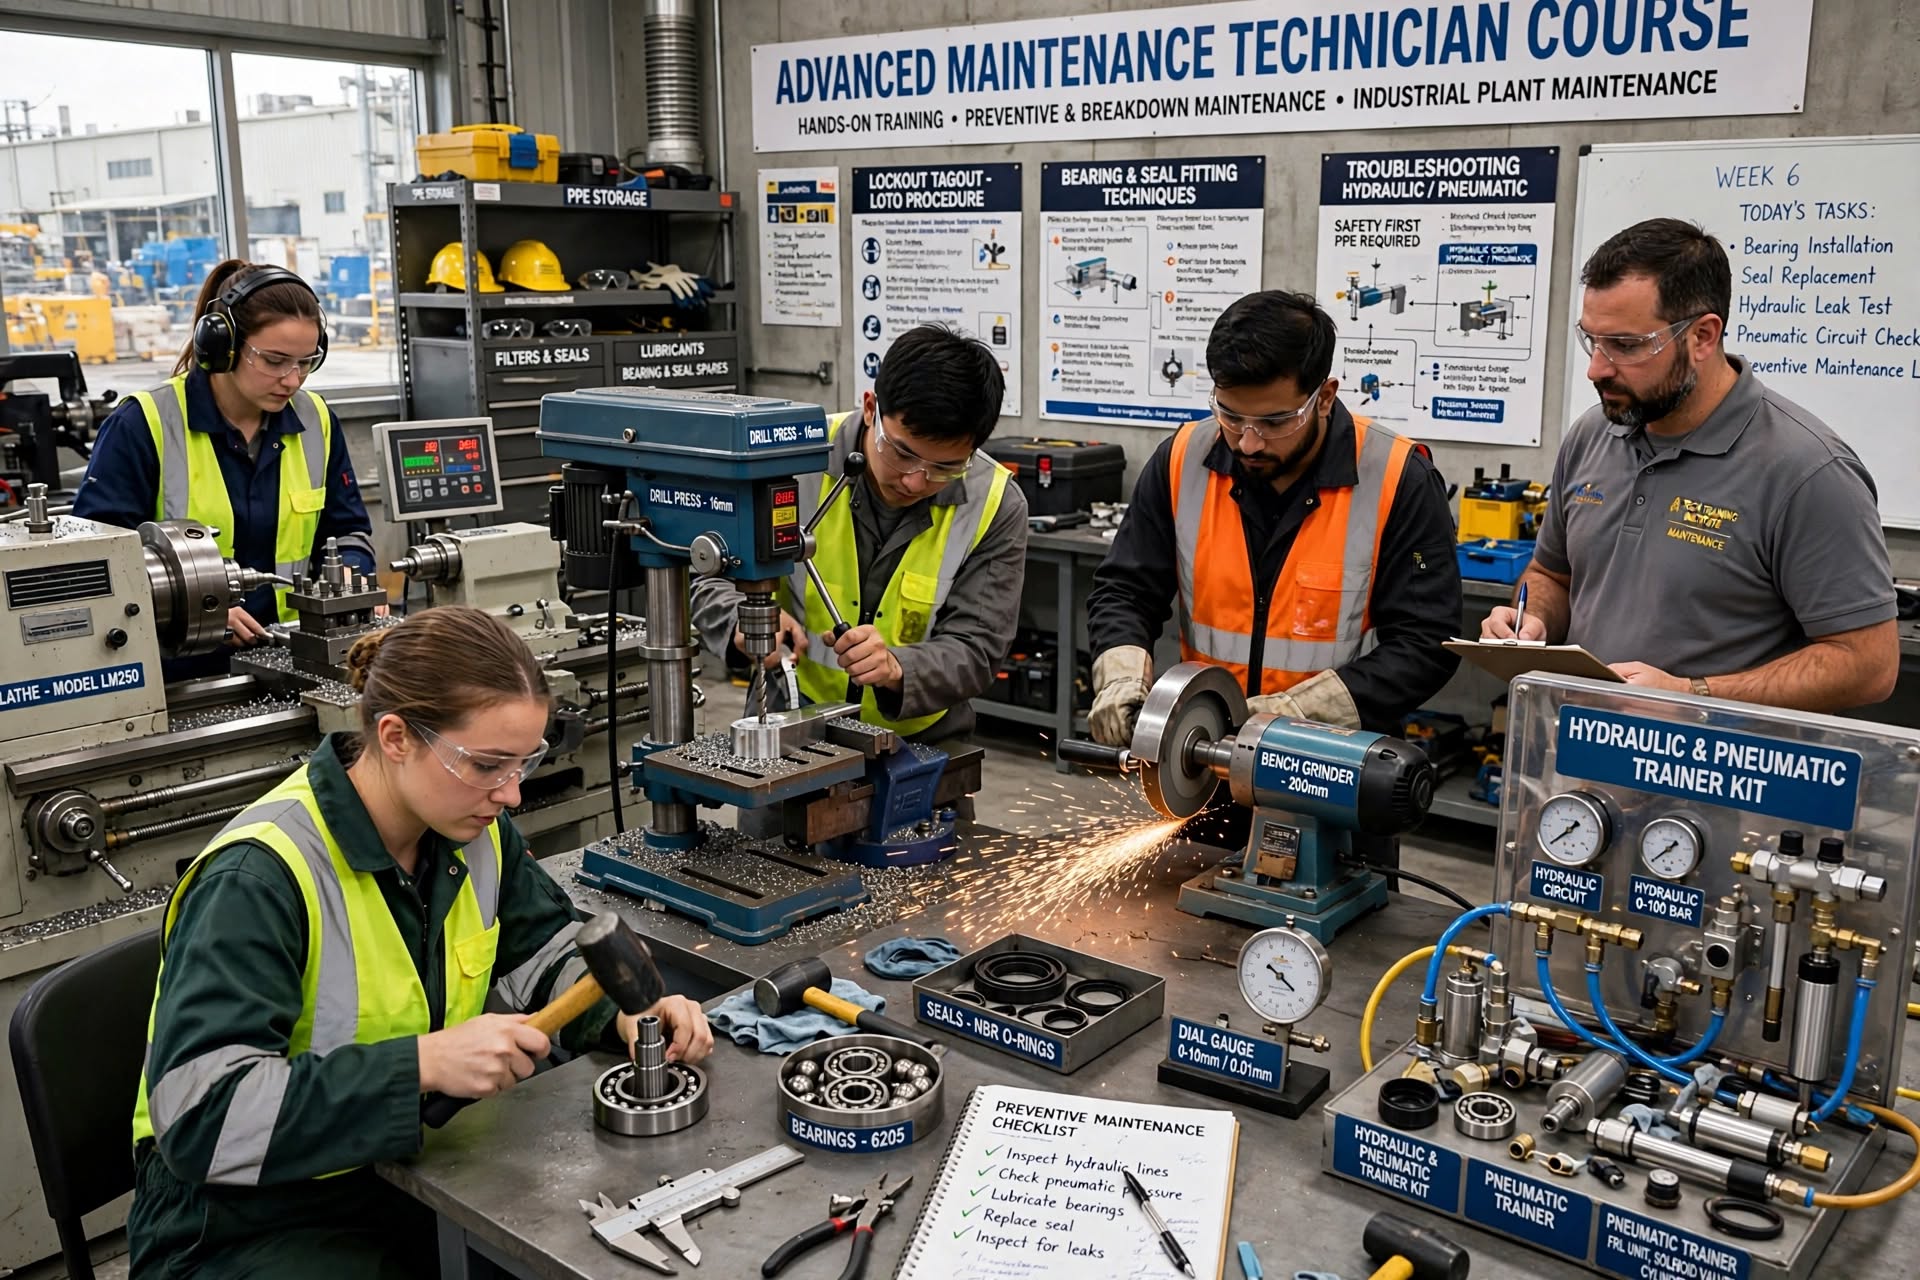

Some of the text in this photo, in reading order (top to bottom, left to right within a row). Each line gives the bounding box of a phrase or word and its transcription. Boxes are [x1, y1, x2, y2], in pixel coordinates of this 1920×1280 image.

[776, 0, 1749, 104] ADVANCED MAINTENANCE TECHNICIAN COURSE
[798, 70, 1718, 135] HANDS-ON TRAINING PREVENTIVE & BREAKDOWN MAINTENANCE INDUSTRIAL PLANT MAINTENANCE
[869, 172, 928, 190] LOCKOUT
[930, 170, 984, 188] TAGOUT
[1061, 163, 1238, 185] BEARING & SEAL FITTING
[1347, 156, 1520, 179] TROUBLESHOOTING
[1715, 163, 1800, 188] WEEK 6
[567, 187, 648, 207] PPE STORAGE
[870, 190, 985, 209] LOTO PROCEDURE
[1102, 187, 1196, 206] TECHNIQUES
[1342, 179, 1529, 199] HYDRAULIC / PNEUMATIC
[1740, 200, 1876, 221] TODAY'S TASKS:
[1335, 219, 1421, 233] SAFETY FIRST
[1335, 235, 1421, 249] PPE REQUIRED
[1744, 235, 1893, 262] Bearing Installation
[1742, 266, 1876, 289] Seal Replacement
[1739, 296, 1893, 320] Hydraulic Leak Test
[1737, 325, 1920, 347] Pneumatic Circuit Check
[495, 348, 590, 366] FILTERS & SEALS
[641, 342, 705, 358] LUBRICANTS
[622, 364, 662, 380] BEARING
[672, 363, 694, 377] SEAL
[695, 362, 728, 375] SPARES
[1740, 354, 1808, 374] eventive
[1815, 357, 1904, 378] Maintenance
[749, 429, 772, 445] DRILL
[773, 426, 797, 442] PRESS
[804, 425, 824, 439] 16mm
[650, 488, 673, 504] DRILL
[674, 491, 701, 508] PRESS
[709, 496, 733, 512] 16mm
[1667, 527, 1725, 550] MAINTENANCE
[0, 685, 40, 706] LATHE
[53, 676, 98, 696] MODEL
[101, 668, 139, 688] LM250
[1568, 716, 1847, 787] HYDRAULIC & PNEUMATIC
[1261, 751, 1354, 786] BENCH GRINDER
[1633, 757, 1768, 804] TRAINER KIT
[1288, 776, 1329, 799] 200mm
[1535, 866, 1597, 891] HYDRAULIC
[1543, 883, 1588, 904] CIRCUIT
[1634, 881, 1698, 907] HYDRAULIC
[1635, 897, 1692, 921] 0-100 BAR
[926, 1000, 964, 1028] SEALS
[974, 1013, 999, 1040] NBR
[1003, 1024, 1055, 1061] O-RINGS
[1179, 1024, 1255, 1059] DIAL GAUGE
[1178, 1043, 1220, 1070] 0-10mm
[1230, 1057, 1272, 1083] 0.01mm
[992, 1117, 1078, 1138] CHECKLIST
[995, 1101, 1206, 1137] PREVENTIVE MAINTENANCE
[791, 1120, 857, 1149] BEARINGS
[871, 1128, 905, 1148] 6205
[1354, 1124, 1438, 1167] HYDRAULIC &
[1006, 1147, 1168, 1178] Inspect hydraulic lines
[1359, 1144, 1431, 1181] PNEUMATIC
[999, 1168, 1183, 1200] Check pneumatic pssure
[1359, 1161, 1430, 1198] TRAINER KIT
[1485, 1170, 1568, 1213] PNEUMATIC
[991, 1188, 1125, 1220] Lubricate bearings
[1494, 1192, 1555, 1229] TRAINER
[983, 1208, 1074, 1232] Replace seal
[976, 1230, 1105, 1259] Inspect for leaks
[1606, 1212, 1737, 1274] PNEUMATIC TRAINER
[1607, 1235, 1625, 1253] FRL
[1627, 1242, 1651, 1263] UNIT,
